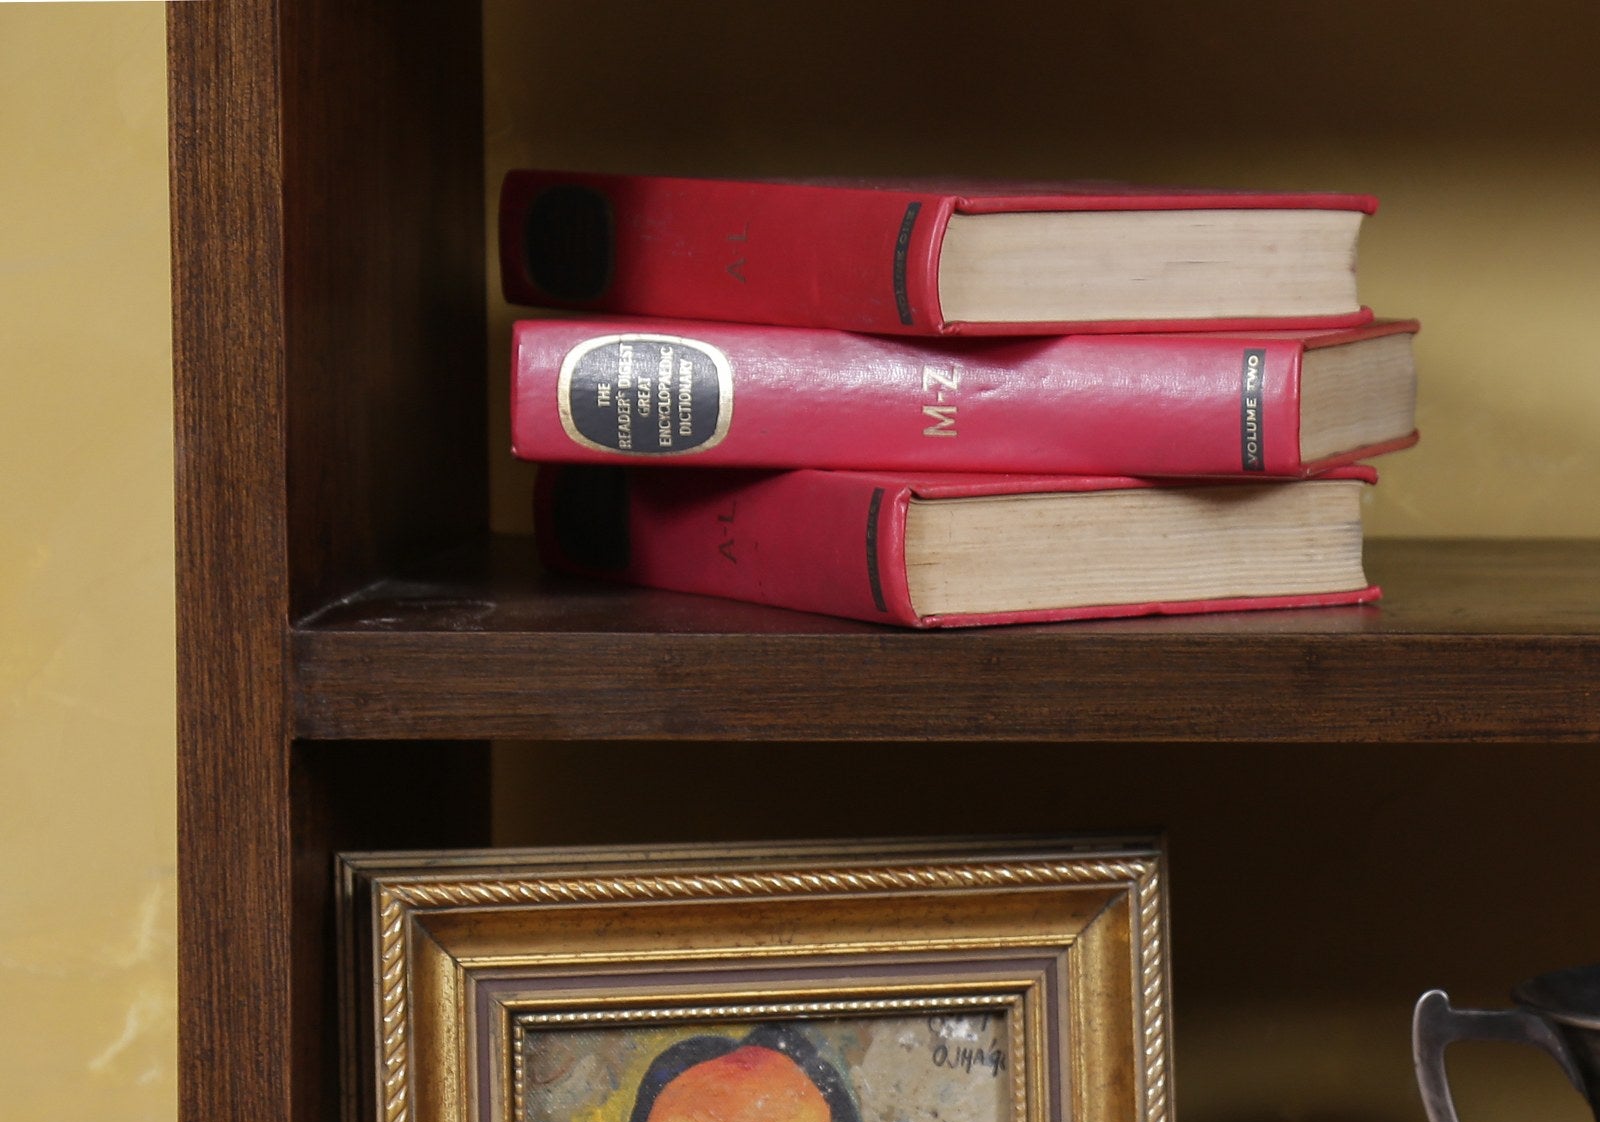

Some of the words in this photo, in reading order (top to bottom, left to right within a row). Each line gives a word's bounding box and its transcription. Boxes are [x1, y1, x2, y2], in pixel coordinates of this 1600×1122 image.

[618, 343, 633, 388] DIGEST
[1246, 355, 1259, 391] TWO
[598, 383, 611, 407] THE
[638, 376, 651, 416] GREAT
[658, 346, 674, 447] ENCYCLOPAEDIC
[678, 358, 693, 436] DICTIONARY
[922, 364, 958, 437] M-Z
[1246, 398, 1258, 464] VOLUME
